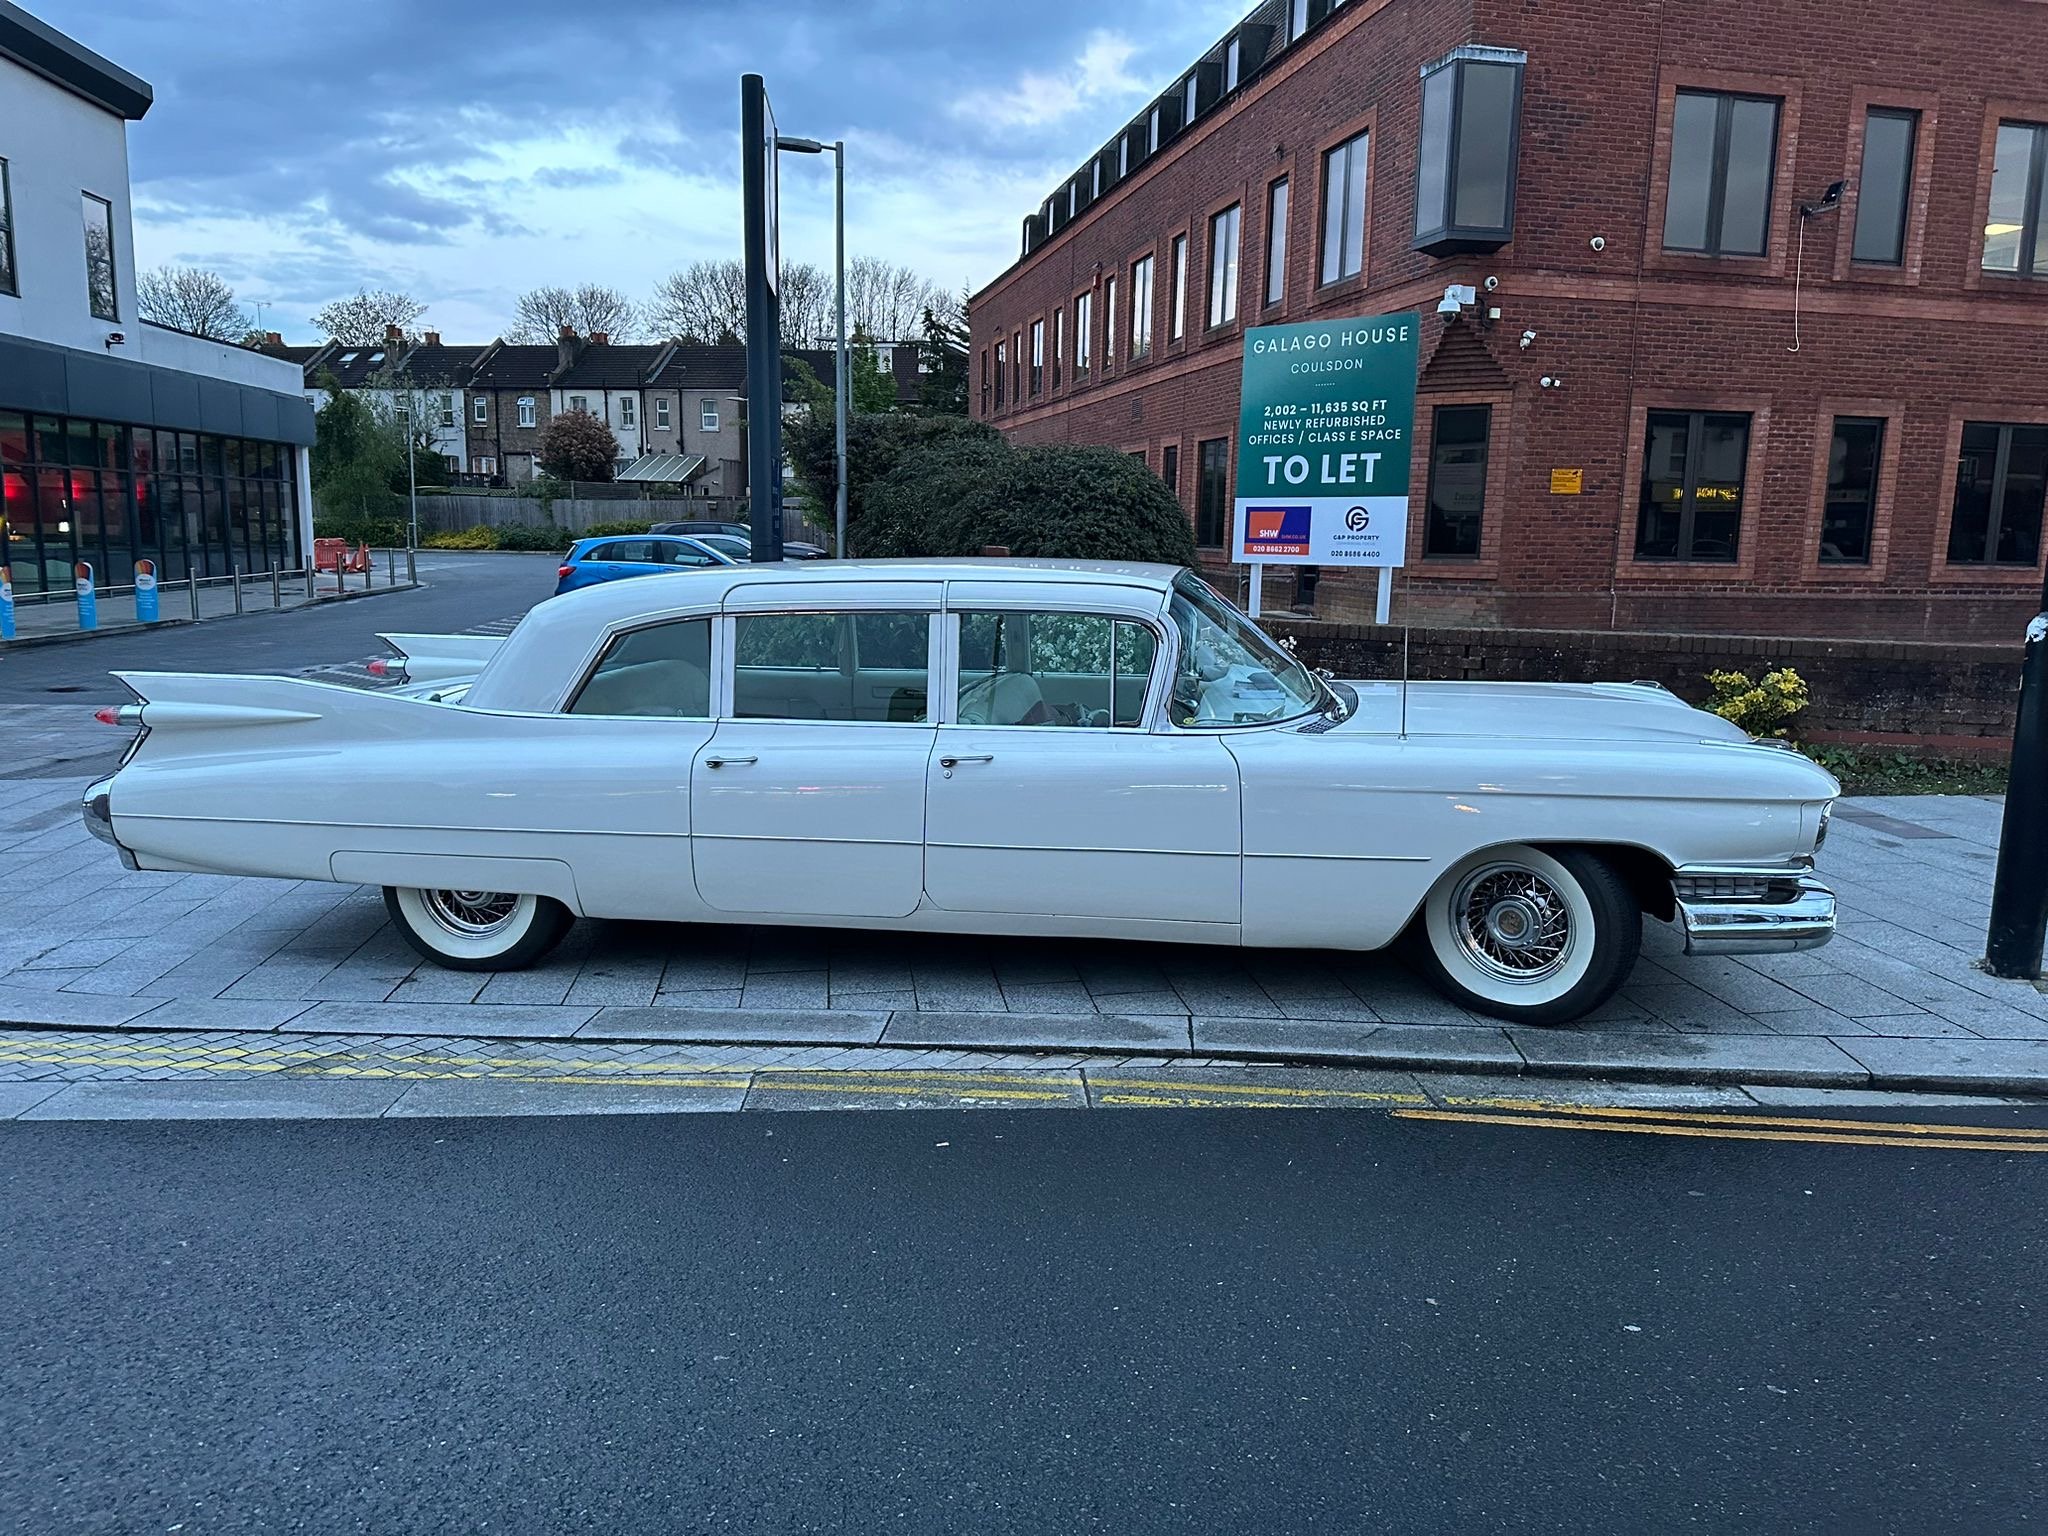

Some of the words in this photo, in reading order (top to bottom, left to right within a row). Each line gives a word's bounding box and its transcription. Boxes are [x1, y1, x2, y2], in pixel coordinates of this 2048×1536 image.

[1253, 333, 1331, 354] GALAGO
[1341, 326, 1409, 347] HOUSE
[1290, 358, 1363, 374] COULSDON
[1263, 404, 1297, 418] 2,002
[1311, 401, 1348, 415] 11,635
[1351, 400, 1369, 413] SQ
[1372, 399, 1387, 411] FT
[1263, 418, 1302, 431] NEWLY
[1305, 414, 1386, 429] REFURBISHED
[1248, 433, 1295, 445] OFFICES
[1308, 431, 1346, 443] CLASS
[1350, 430, 1357, 441] E
[1360, 428, 1401, 441] SPACE
[1263, 454, 1310, 485] TO
[1320, 452, 1382, 484] LET
[1259, 529, 1279, 538] SHW
